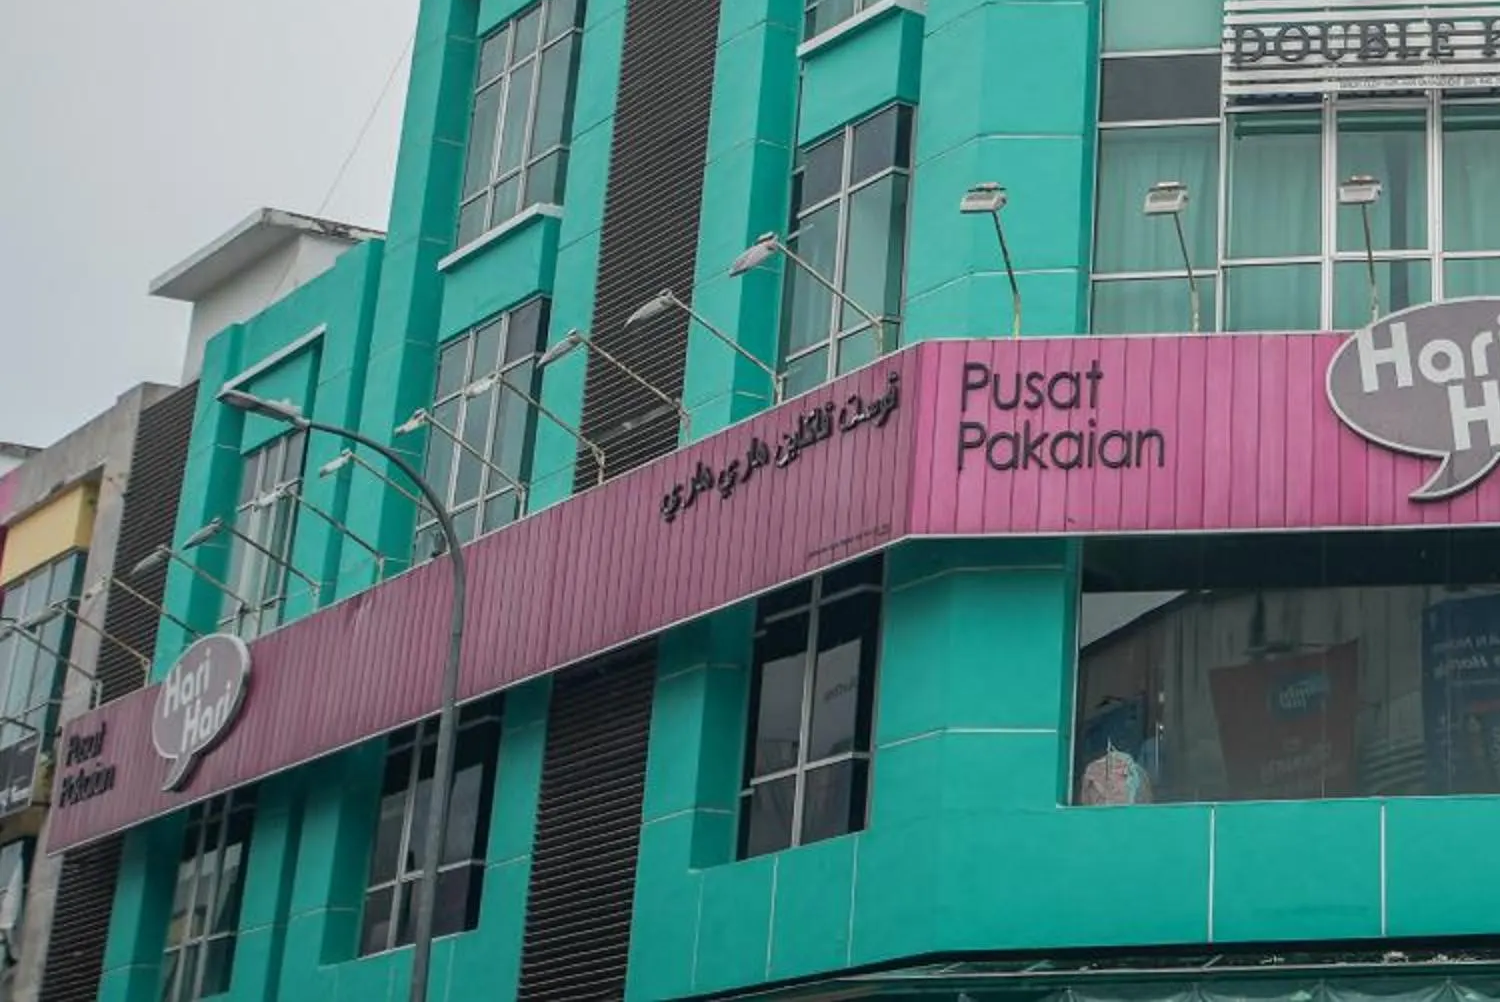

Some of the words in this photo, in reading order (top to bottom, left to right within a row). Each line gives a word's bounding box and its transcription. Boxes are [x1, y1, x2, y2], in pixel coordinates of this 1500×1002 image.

[1231, 22, 1455, 64] DOUBLE
[961, 359, 1104, 413] Pusat
[957, 420, 1165, 471] Pakaian
[164, 648, 211, 717] Hari
[181, 680, 232, 753] Hari
